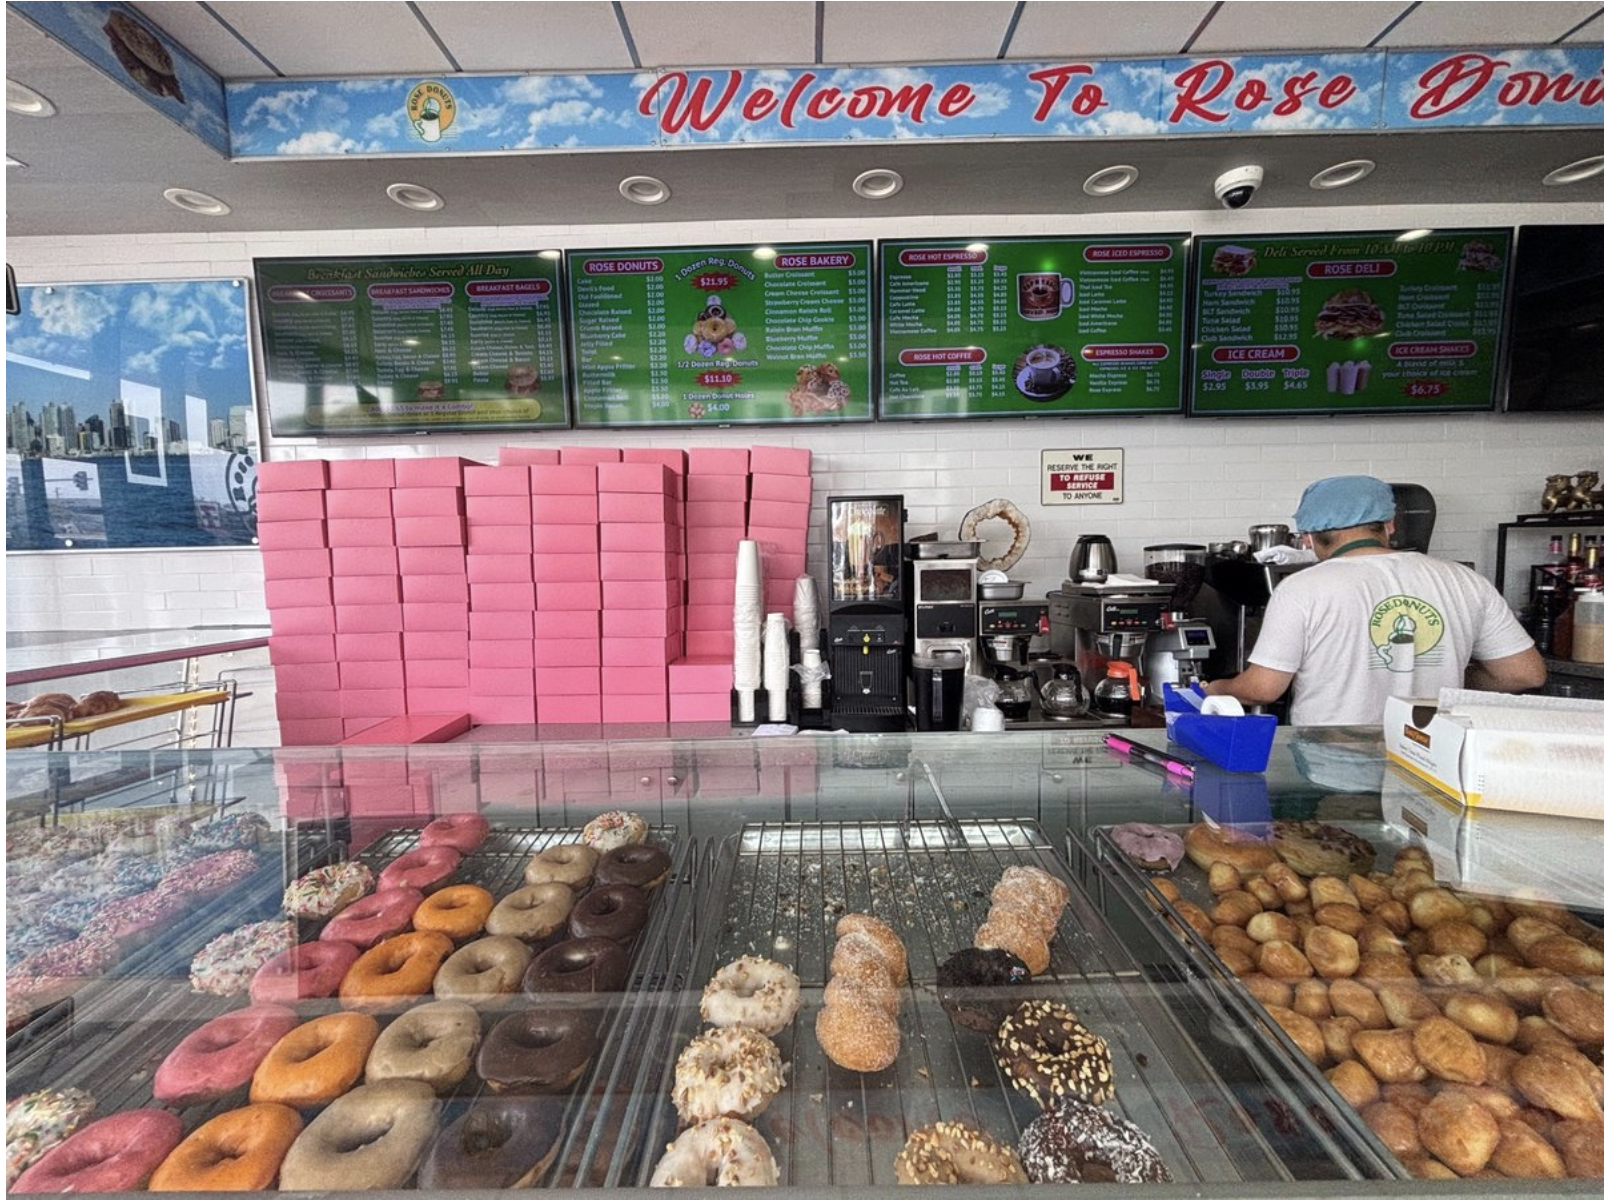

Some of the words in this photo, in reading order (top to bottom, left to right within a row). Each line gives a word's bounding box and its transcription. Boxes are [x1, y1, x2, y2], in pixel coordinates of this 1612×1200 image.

[411, 89, 423, 111] ROSE
[427, 86, 452, 109] DONUTS
[639, 68, 977, 135] Welcome
[1028, 64, 1109, 123] To
[1168, 59, 1358, 123] Rose
[589, 262, 615, 272] ROSE
[617, 261, 658, 271] DONUTS
[781, 257, 807, 267] ROSE
[810, 256, 849, 266] BAKERY
[680, 258, 707, 277] Dozen
[728, 258, 756, 281] Donuts
[1325, 264, 1351, 274] ROSE
[1355, 264, 1379, 274] DELI
[700, 276, 729, 286] $21.95
[1228, 350, 1244, 359] ICE
[1248, 349, 1285, 359] CREAM
[704, 374, 732, 384] $11.10
[1201, 369, 1231, 380] Single
[1242, 369, 1276, 378] Double
[1282, 368, 1310, 379] Triple
[1203, 383, 1226, 391] $2.95
[1245, 382, 1269, 390] $3.95
[1284, 381, 1307, 390] $4.65
[1411, 384, 1440, 395] $6.75
[708, 403, 730, 412] $4.00
[1372, 602, 1394, 627] ROSE
